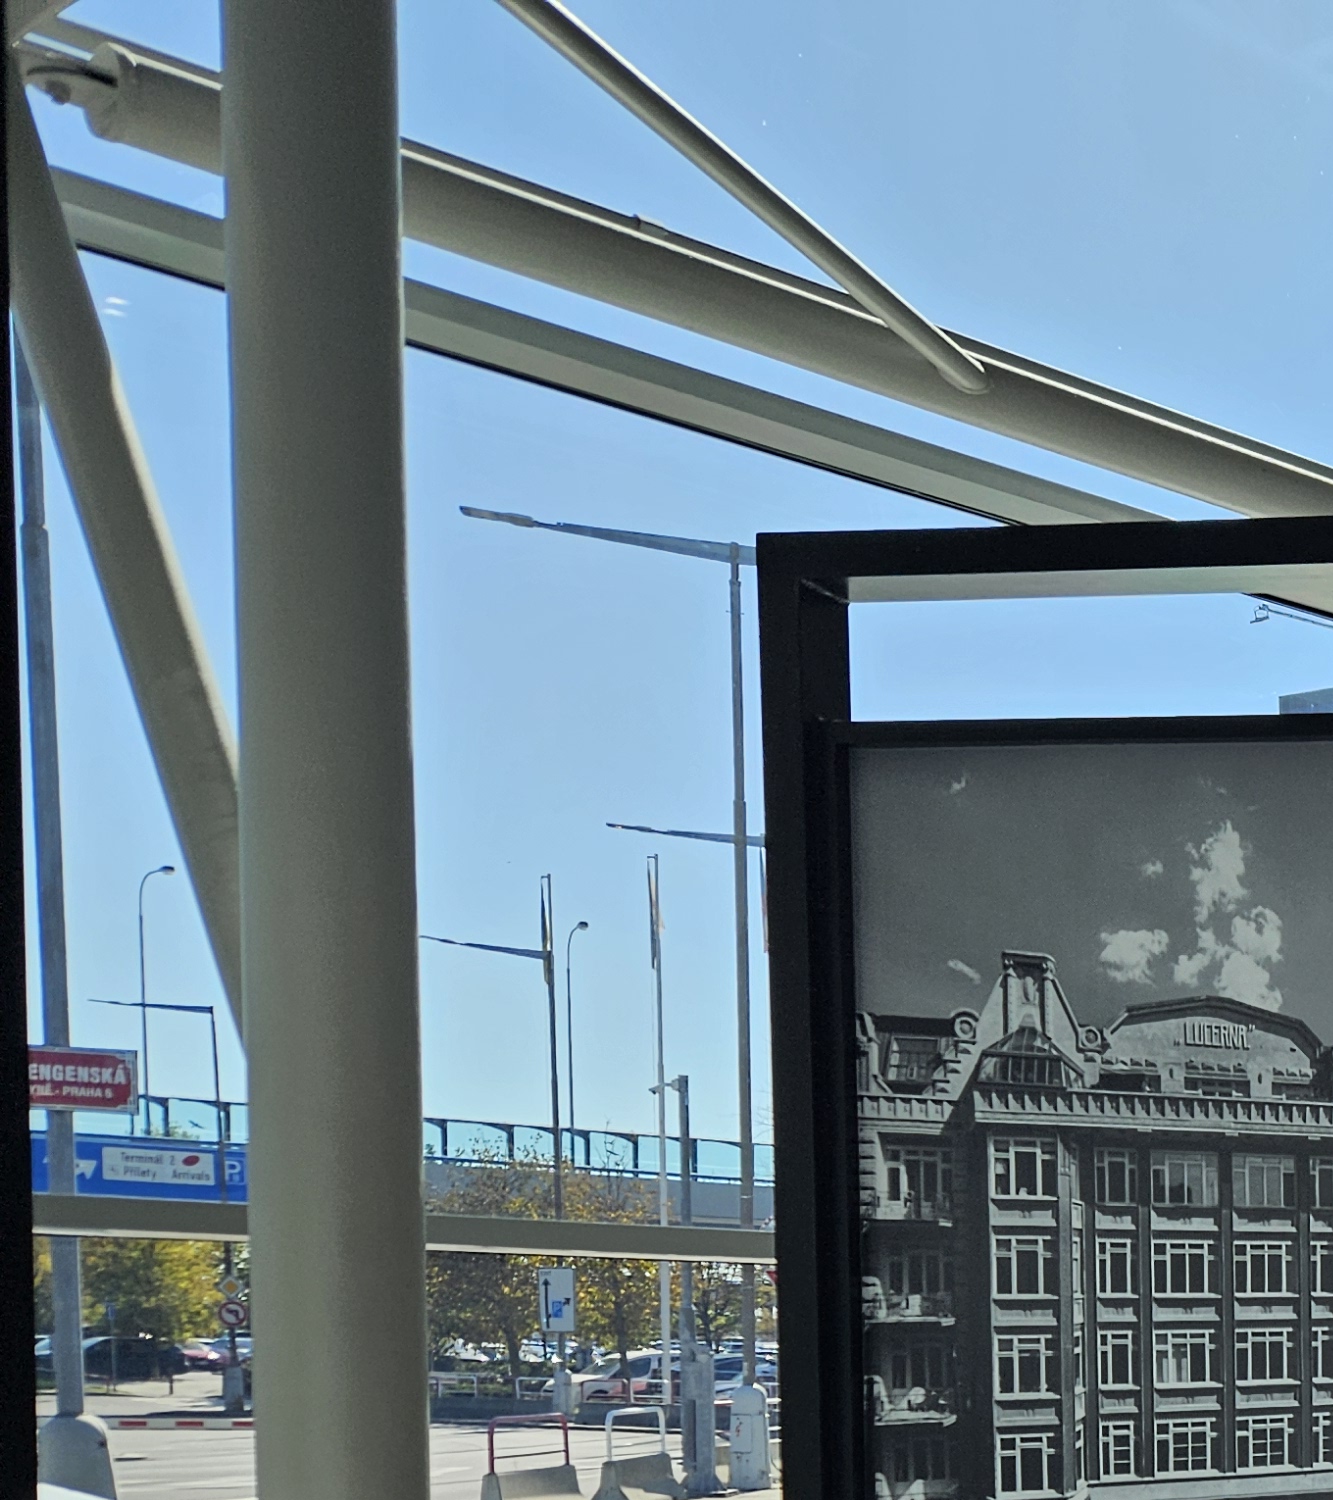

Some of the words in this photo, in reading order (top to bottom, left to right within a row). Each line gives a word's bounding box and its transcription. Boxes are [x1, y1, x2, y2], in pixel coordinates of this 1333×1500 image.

[62, 1086, 103, 1098] PRAHA
[120, 1152, 164, 1165] Terminál
[169, 1156, 176, 1166] 2
[171, 1170, 212, 1182] Arrivals
